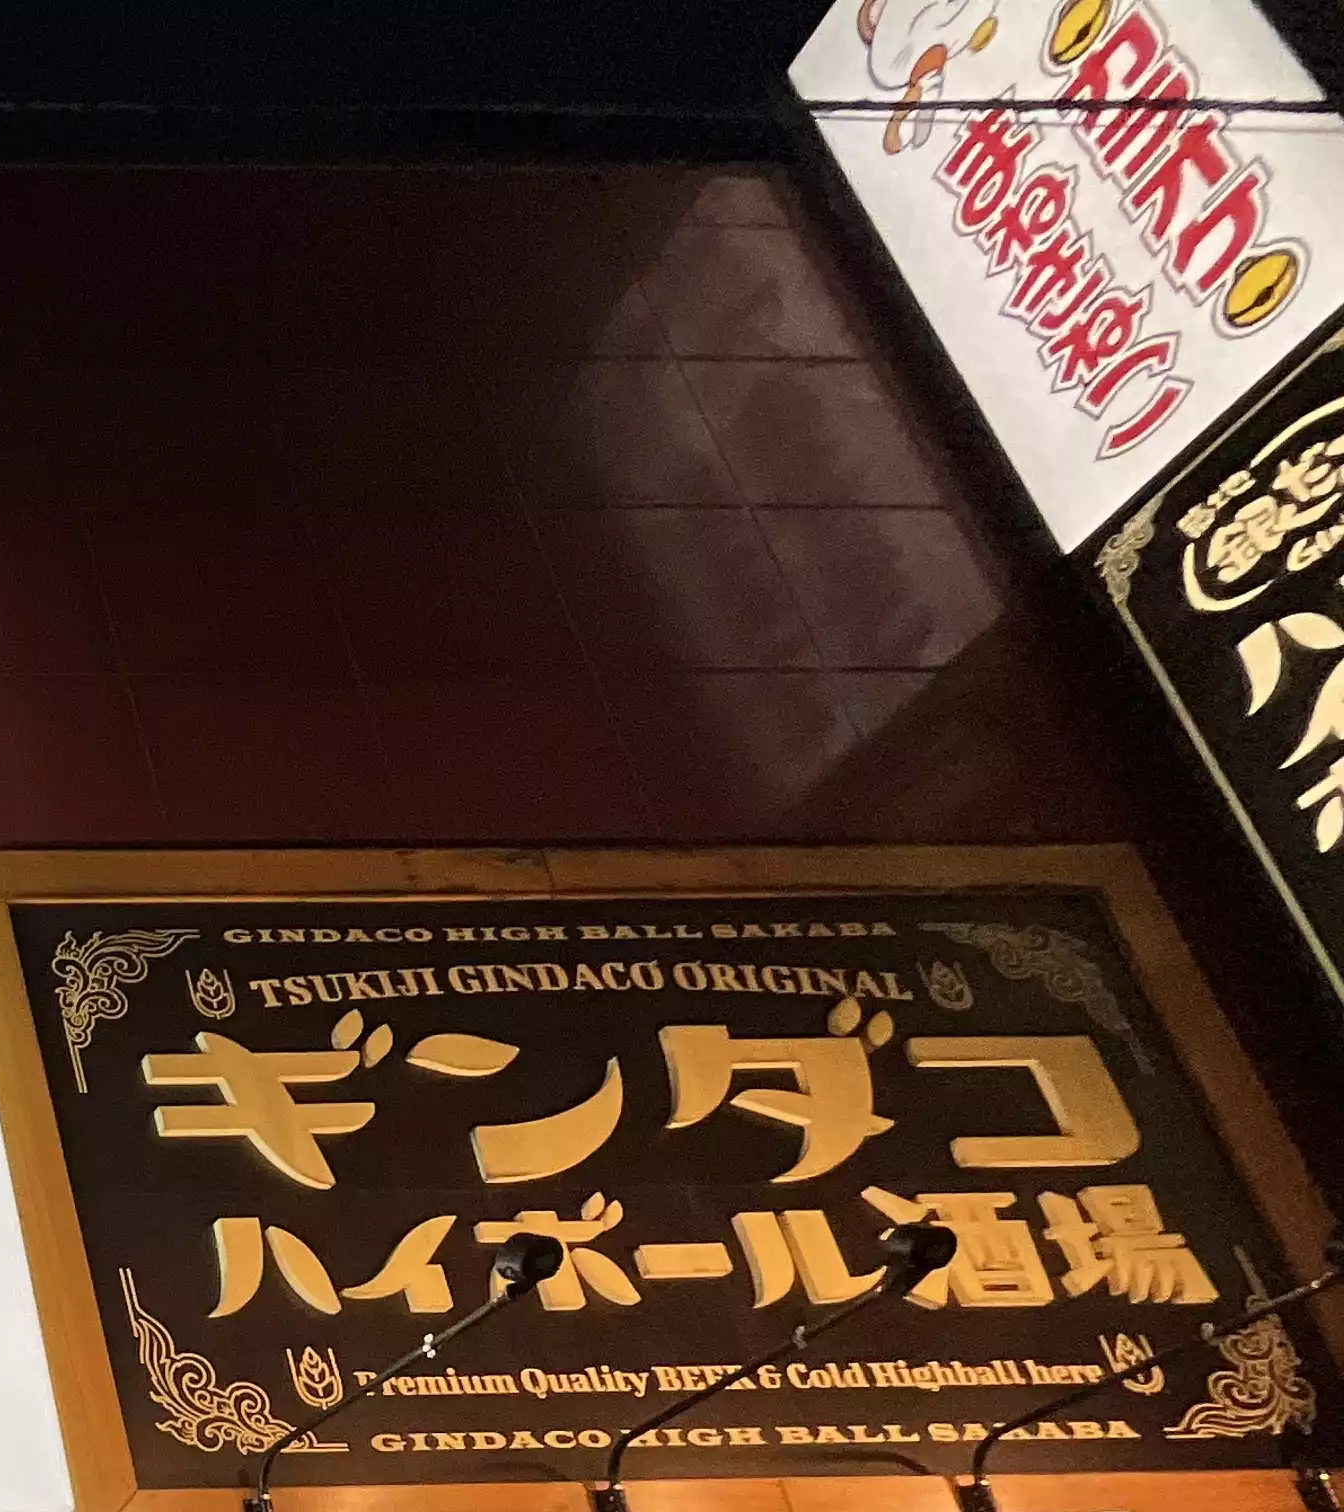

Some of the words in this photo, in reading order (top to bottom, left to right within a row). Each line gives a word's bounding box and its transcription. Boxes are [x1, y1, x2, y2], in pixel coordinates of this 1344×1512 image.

[1065, 8, 1264, 296] カラオケ
[939, 96, 1190, 456] まねきねこ
[222, 927, 434, 945] GINDACO
[441, 926, 569, 942] HIGH
[579, 924, 704, 941] BALL
[709, 921, 899, 940] SAKABA
[249, 966, 447, 1011] TSUKIJI
[447, 959, 664, 995] GINDACO
[663, 961, 914, 1002] ORIGINAL
[141, 998, 1142, 1190] ギンダコ
[520, 1363, 650, 1399] Quality
[787, 1361, 870, 1390] Cold
[867, 1359, 1028, 1393] Highball
[1023, 1358, 1105, 1385] here
[371, 1428, 613, 1453] GINDACO
[774, 1423, 921, 1445] BALL
